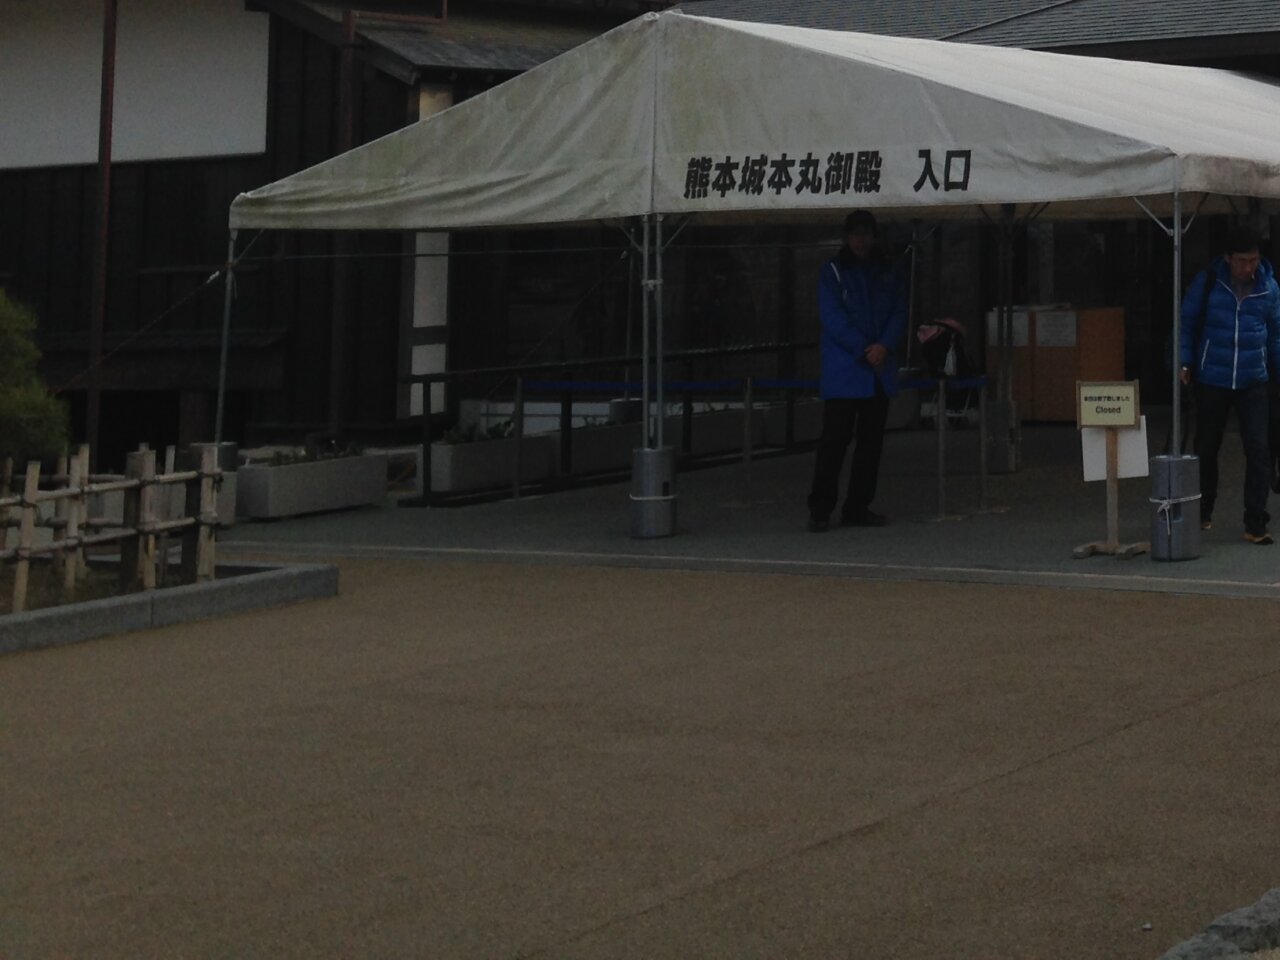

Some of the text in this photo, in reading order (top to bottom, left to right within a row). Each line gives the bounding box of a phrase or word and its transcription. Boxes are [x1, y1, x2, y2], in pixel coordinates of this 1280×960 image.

[684, 148, 971, 199] 熊本城本丸御殿 入口
[1096, 406, 1121, 414] Closed
